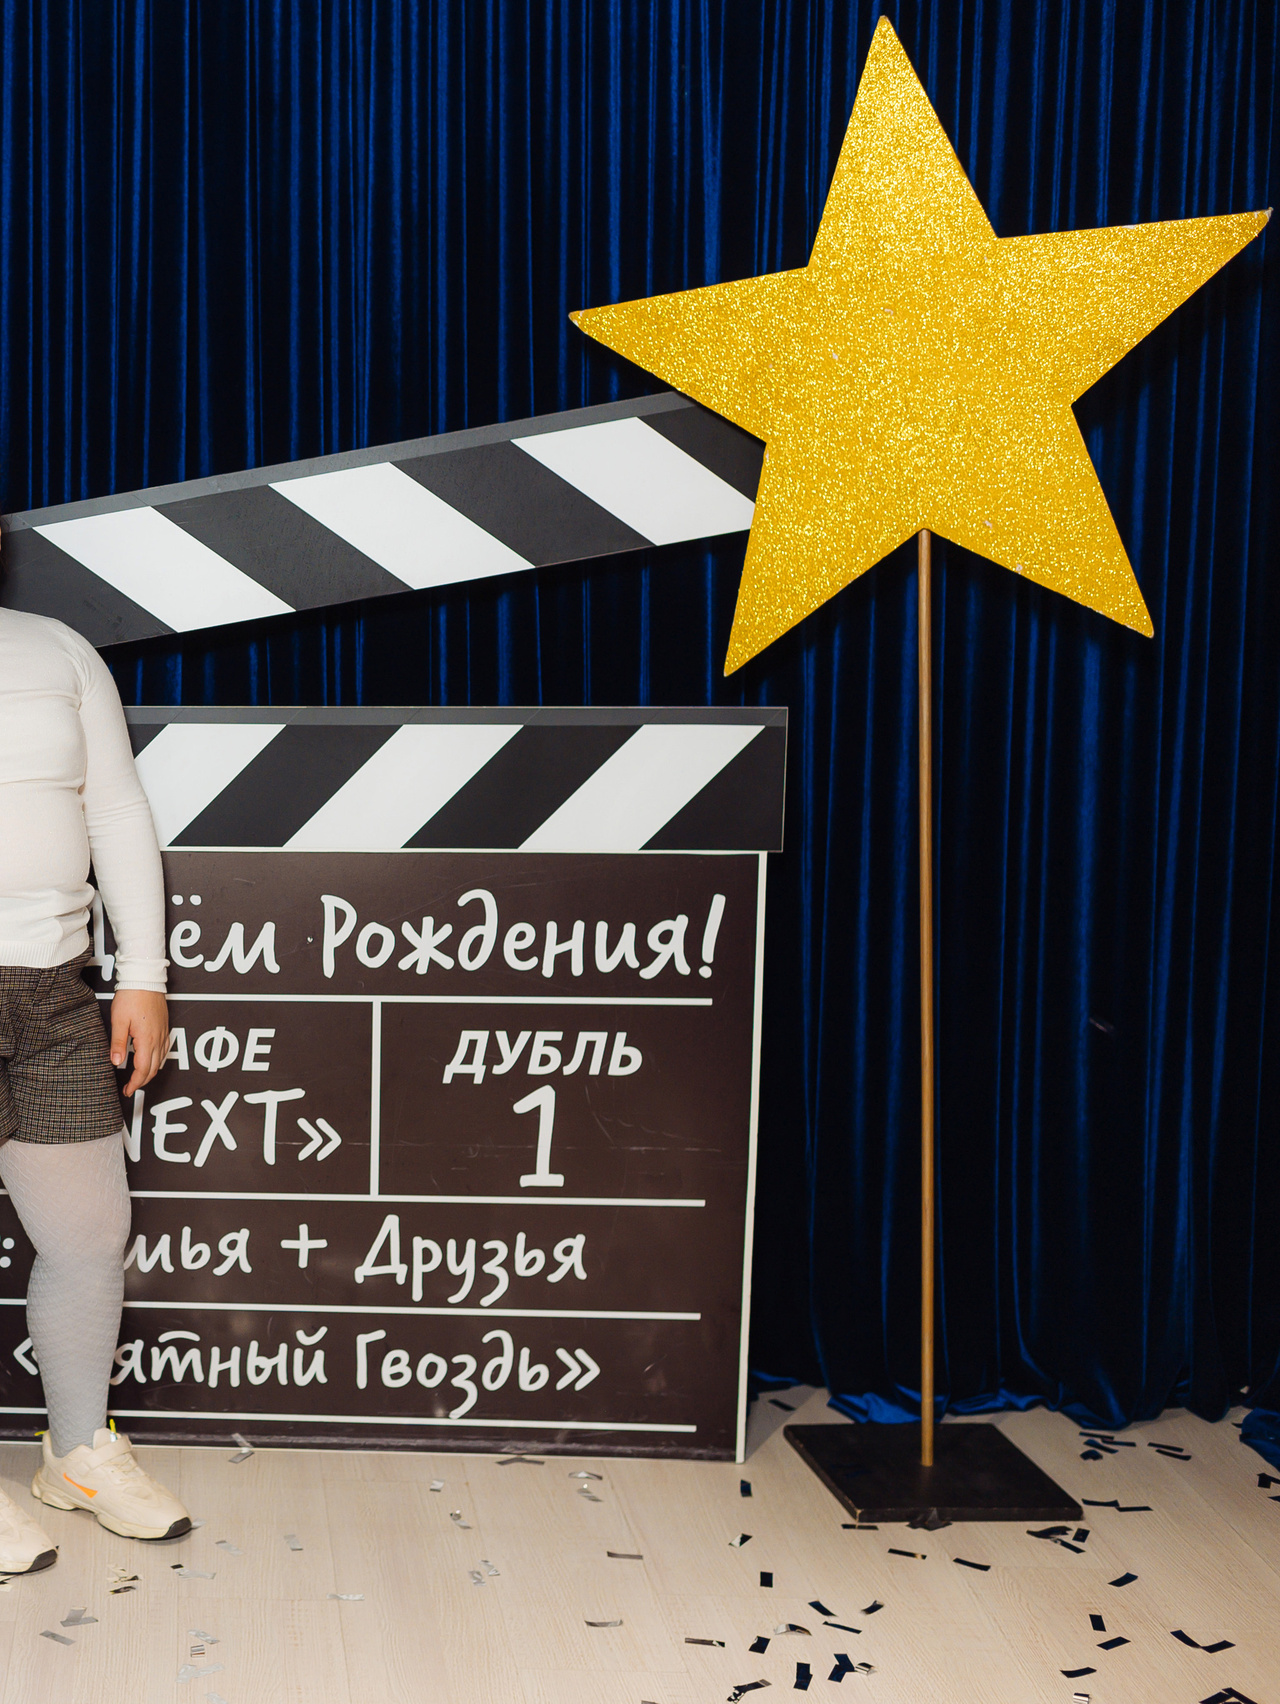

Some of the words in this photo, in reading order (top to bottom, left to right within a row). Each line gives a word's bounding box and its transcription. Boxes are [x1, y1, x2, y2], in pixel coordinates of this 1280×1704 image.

[321, 888, 726, 980] Рождения!
[117, 1026, 276, 1073] АФЕ
[442, 1030, 643, 1085] ДУБЛЬ
[512, 1084, 565, 1188] 1
[122, 1225, 252, 1276] мья
[280, 1223, 328, 1269] +
[354, 1214, 588, 1307] Друзья
[356, 1328, 601, 1420] Гвоздь»
